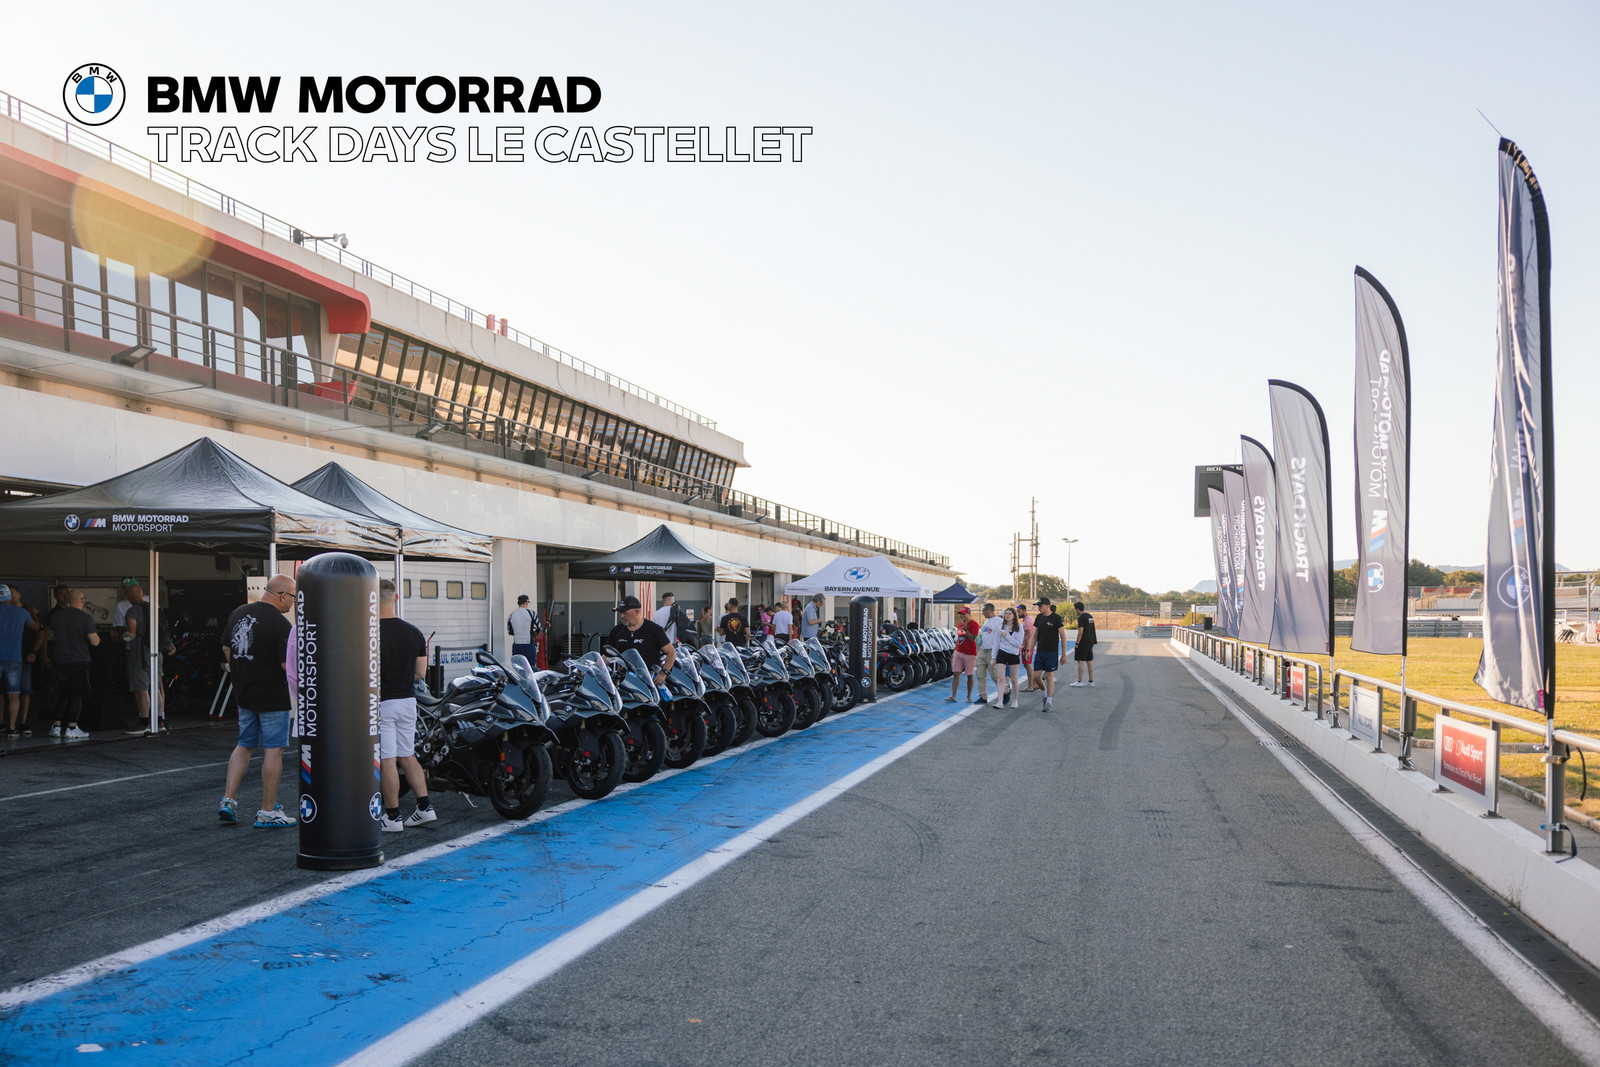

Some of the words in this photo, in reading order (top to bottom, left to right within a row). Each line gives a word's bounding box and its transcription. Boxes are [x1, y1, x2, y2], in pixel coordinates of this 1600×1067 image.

[112, 514, 135, 522] BMW
[138, 515, 189, 523] MOTORRAD
[112, 524, 173, 532] MOTORSPORT
[297, 590, 305, 688] MOTORRAD
[369, 591, 378, 688] MOTORRAD
[450, 651, 473, 663] RICARD
[306, 620, 317, 737] MOTORSPORT
[369, 693, 378, 736] BMW
[302, 745, 311, 768] M
[1470, 745, 1484, 762] Sport
